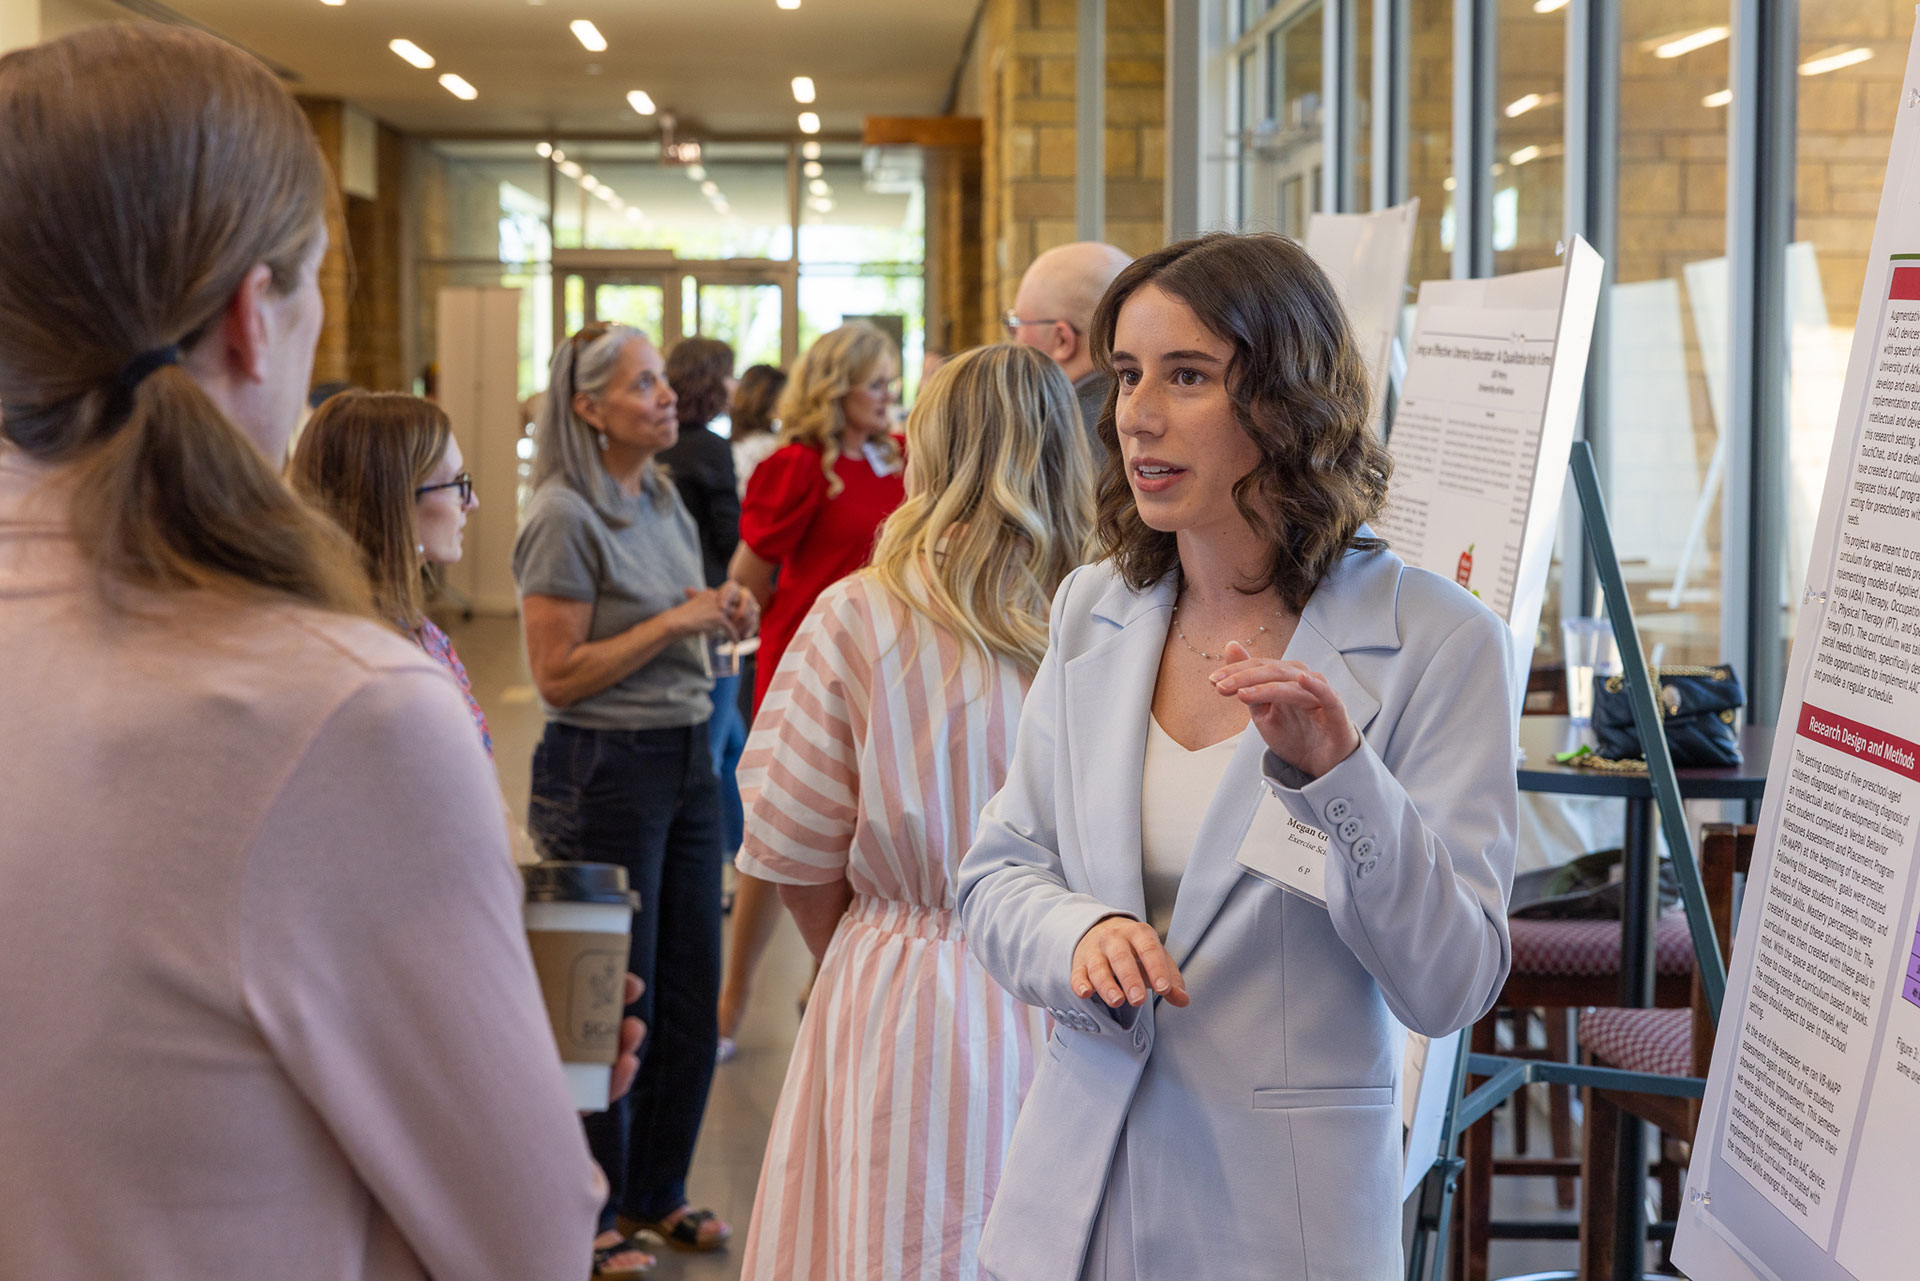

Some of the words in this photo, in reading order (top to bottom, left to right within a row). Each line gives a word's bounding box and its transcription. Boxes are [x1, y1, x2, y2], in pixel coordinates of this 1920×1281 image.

[1893, 344, 1912, 358] speech
[1903, 362, 1911, 374] of
[1893, 379, 1906, 392] and
[1895, 415, 1908, 427] and
[1872, 431, 1895, 443] research
[1894, 434, 1917, 449] setting,
[1867, 465, 1889, 478] created
[1886, 450, 1899, 462] and
[1876, 483, 1888, 496] this
[1887, 485, 1901, 499] AAC
[1865, 498, 1874, 510] for
[1872, 502, 1910, 518] preschoolers
[1849, 536, 1870, 550] project
[1870, 541, 1882, 553] was
[1881, 544, 1902, 557] meant
[1901, 547, 1910, 559] to
[1862, 554, 1873, 568] for
[1871, 559, 1894, 573] special
[1893, 565, 1912, 578] needs
[1866, 576, 1889, 591] models
[1888, 580, 1898, 592] of
[1848, 588, 1865, 605] (ABA)
[1864, 591, 1889, 612] Therapy,
[1837, 602, 1861, 620] Physical
[1860, 608, 1885, 629] Therapy
[1884, 616, 1900, 633] (PT),
[1900, 622, 1913, 634] and
[1841, 622, 1855, 638] (ST).
[1856, 625, 1868, 640] The
[1867, 632, 1900, 649] curriculum
[1900, 641, 1912, 653] was
[1834, 640, 1853, 654] needs
[1852, 644, 1878, 664] children,
[1878, 653, 1911, 674] specifically
[1820, 672, 1842, 687] provide
[1846, 680, 1867, 695] regular
[1866, 686, 1894, 704] schedule.
[1833, 658, 1871, 678] opportunities
[1870, 668, 1879, 680] to
[1878, 669, 1909, 690] implement
[1808, 716, 1841, 741] Research
[1841, 728, 1867, 753] Design
[1867, 741, 1885, 757] and
[1883, 744, 1915, 770] Methods
[1795, 748, 1805, 764] This
[1804, 755, 1822, 773] setting
[1821, 763, 1844, 779] consists
[1843, 770, 1851, 782] of
[1850, 771, 1862, 787] five
[1861, 779, 1902, 804] preschool-aged
[1791, 767, 1811, 784] children
[1810, 775, 1838, 796] diagnosed
[1837, 787, 1850, 801] with
[1856, 796, 1880, 817] awaiting
[1879, 804, 1903, 824] diagnosis
[1794, 785, 1823, 808] intellectual
[1822, 800, 1843, 816] and/or
[1841, 806, 1882, 834] developmental
[1287, 817, 1316, 837] Megan
[1288, 833, 1316, 851] Exercise
[1785, 799, 1797, 814] Each
[1795, 806, 1816, 823] student
[1815, 815, 1845, 836] completed
[1849, 827, 1867, 846] Verbal
[1865, 835, 1889, 855] Behavior
[1782, 817, 1806, 838] Milestones
[1804, 828, 1836, 851] Assessment
[1846, 845, 1874, 870] Placement
[1873, 859, 1895, 879] Program
[1304, 867, 1311, 875] P
[1779, 833, 1803, 857] (VB-MAPP)
[1809, 848, 1819, 862] the
[1818, 851, 1845, 877] beginning
[1851, 868, 1861, 883] the
[1860, 875, 1885, 895] semester.
[1776, 849, 1798, 873] Following
[1797, 860, 1808, 875] this
[1806, 867, 1838, 892] assessment,
[1837, 883, 1853, 898] goals
[1852, 890, 1866, 905] were
[1865, 897, 1887, 915] created
[1779, 872, 1792, 886] each
[1797, 879, 1812, 896] these
[1810, 888, 1835, 908] students
[1840, 903, 1859, 922] speech,
[1877, 923, 1888, 937] and
[1766, 901, 1785, 918] created
[1783, 908, 1792, 922] for
[1790, 915, 1803, 929] each
[1808, 924, 1825, 941] these
[1824, 933, 1847, 953] students
[1863, 952, 1874, 969] The
[1791, 896, 1806, 913] skills.
[1806, 903, 1828, 926] Mastery
[1826, 916, 1859, 941] percentages
[1859, 933, 1872, 948] were
[1791, 954, 1807, 970] space
[1816, 968, 1851, 996] opportunities
[1795, 936, 1808, 951] then
[1807, 944, 1830, 963] created
[1829, 955, 1841, 970] with
[1840, 961, 1856, 979] these
[1854, 971, 1870, 987] goals
